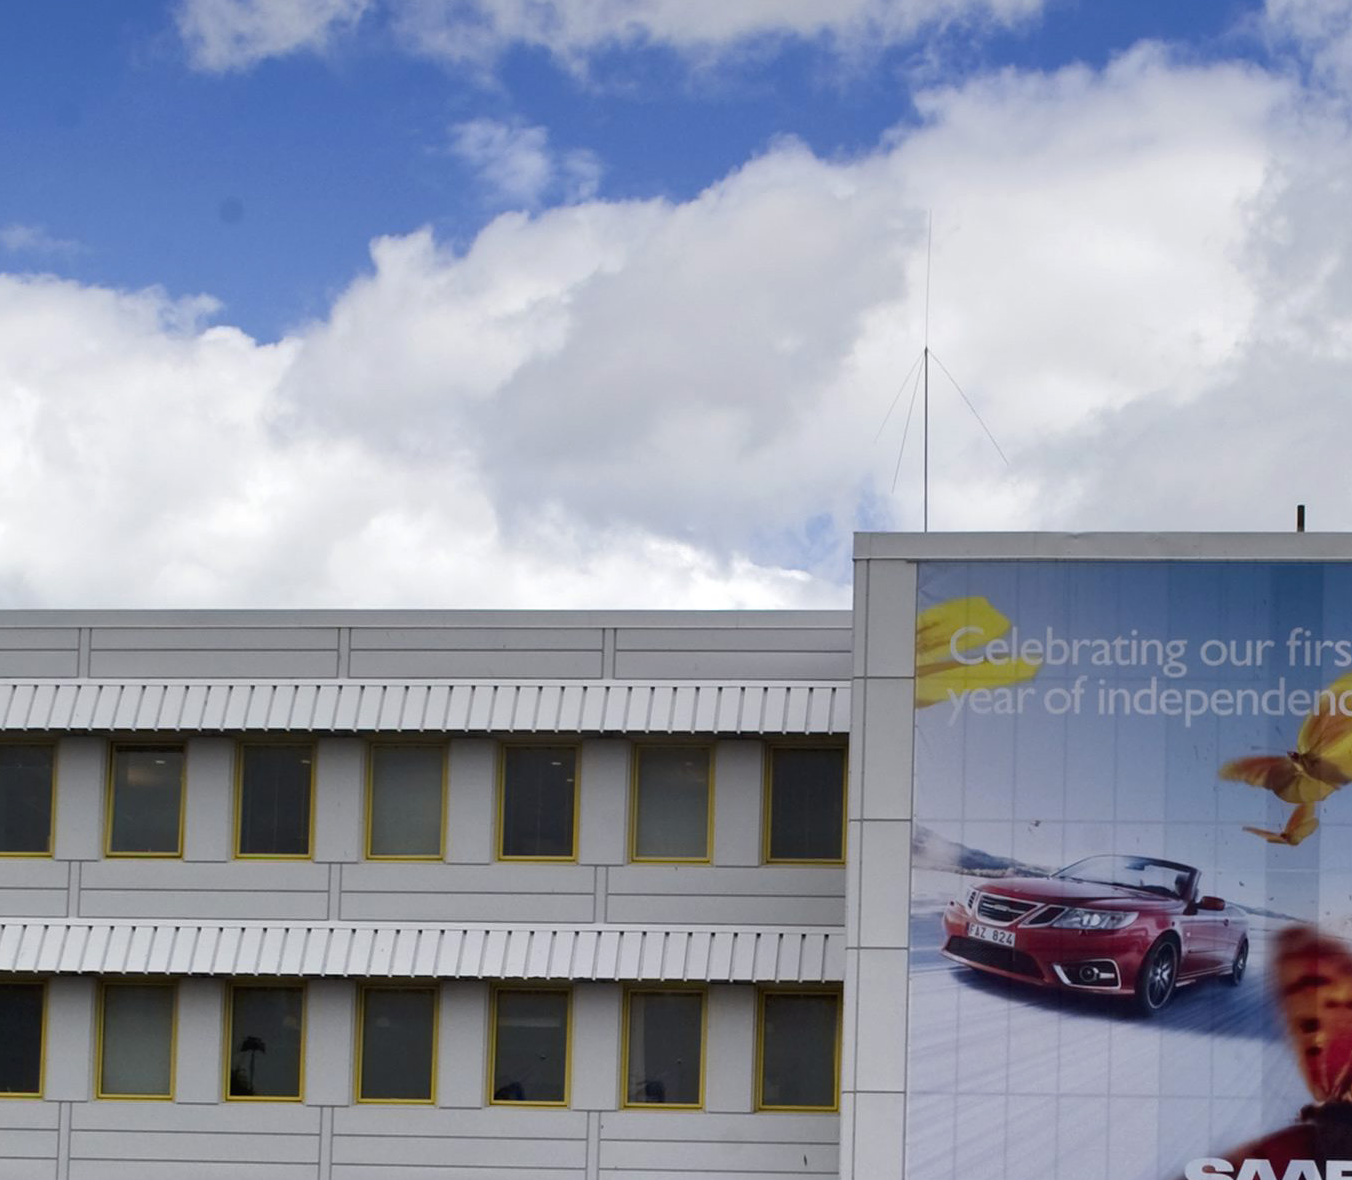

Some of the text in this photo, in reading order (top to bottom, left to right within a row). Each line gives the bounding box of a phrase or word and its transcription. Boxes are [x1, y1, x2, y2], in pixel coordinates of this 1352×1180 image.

[949, 626, 1188, 678] Celebrating
[1200, 639, 1275, 667] our
[947, 686, 1035, 727] year
[1044, 675, 1088, 715] of
[992, 929, 1013, 945] 824
